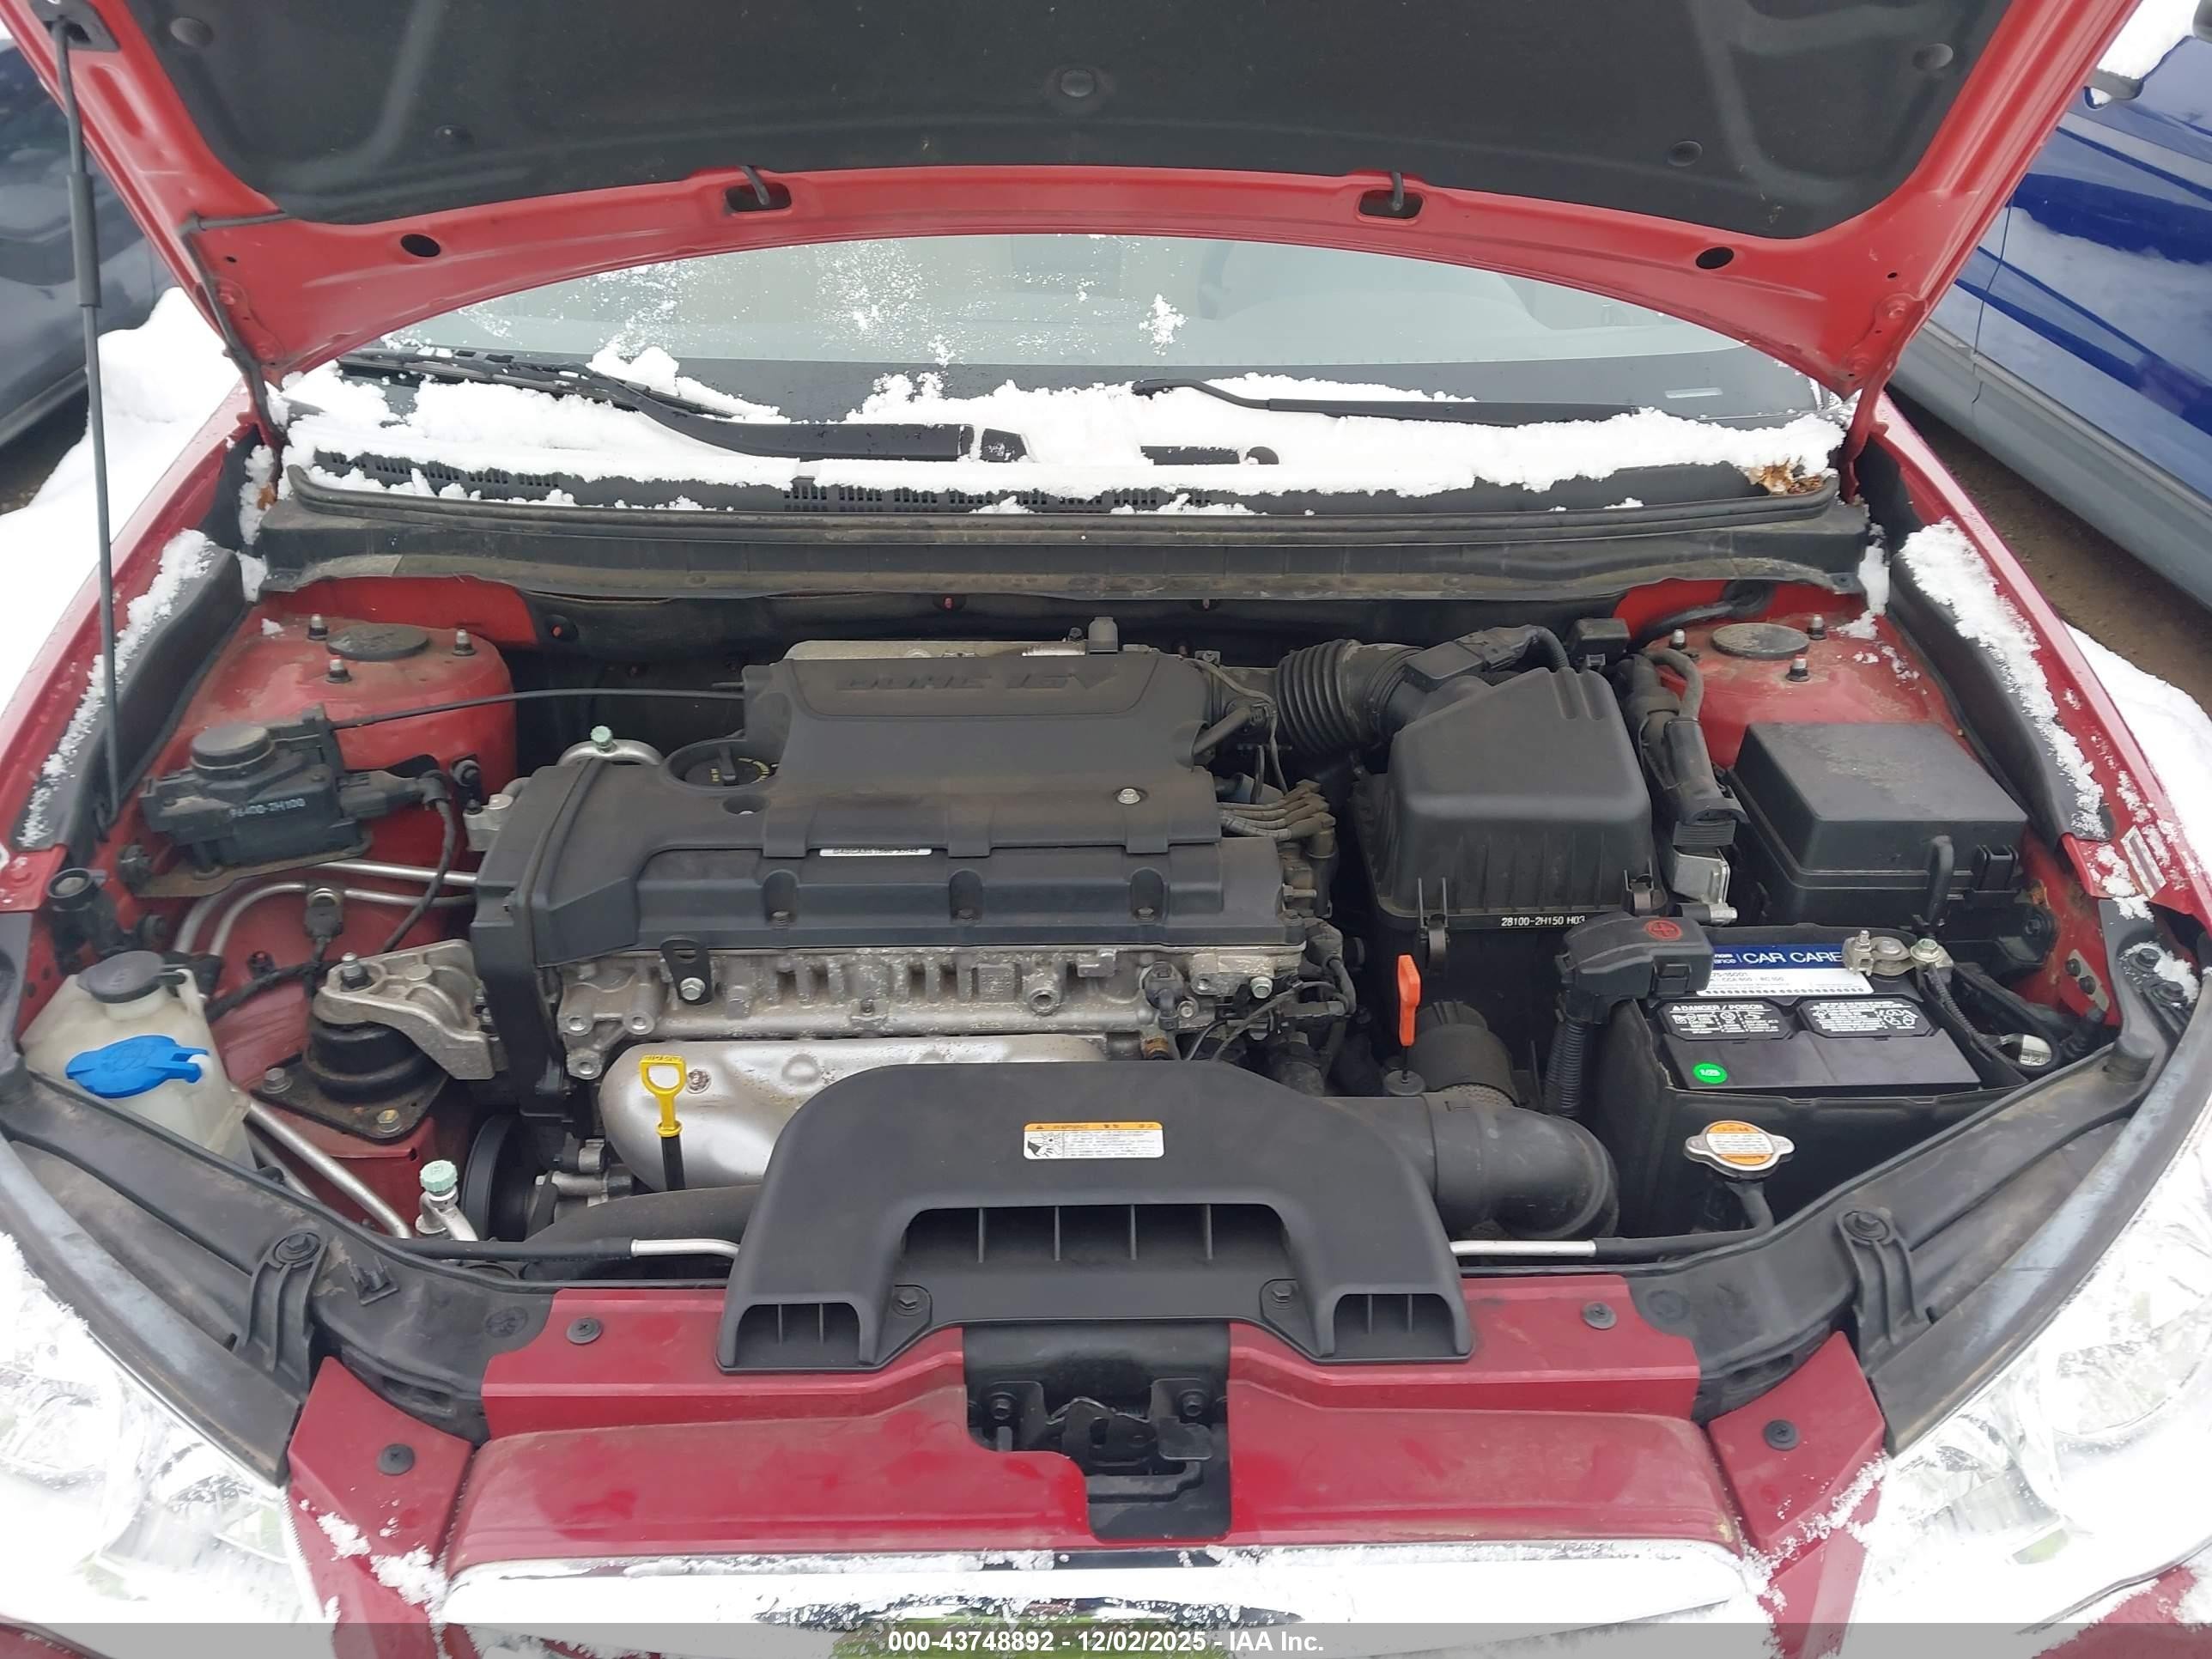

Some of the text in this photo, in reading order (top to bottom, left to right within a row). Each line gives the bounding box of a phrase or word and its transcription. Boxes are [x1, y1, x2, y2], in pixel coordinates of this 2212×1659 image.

[1501, 915, 1565, 927] 28100-2H150
[1743, 951, 1787, 963] CAR
[1790, 951, 1843, 963] CARE
